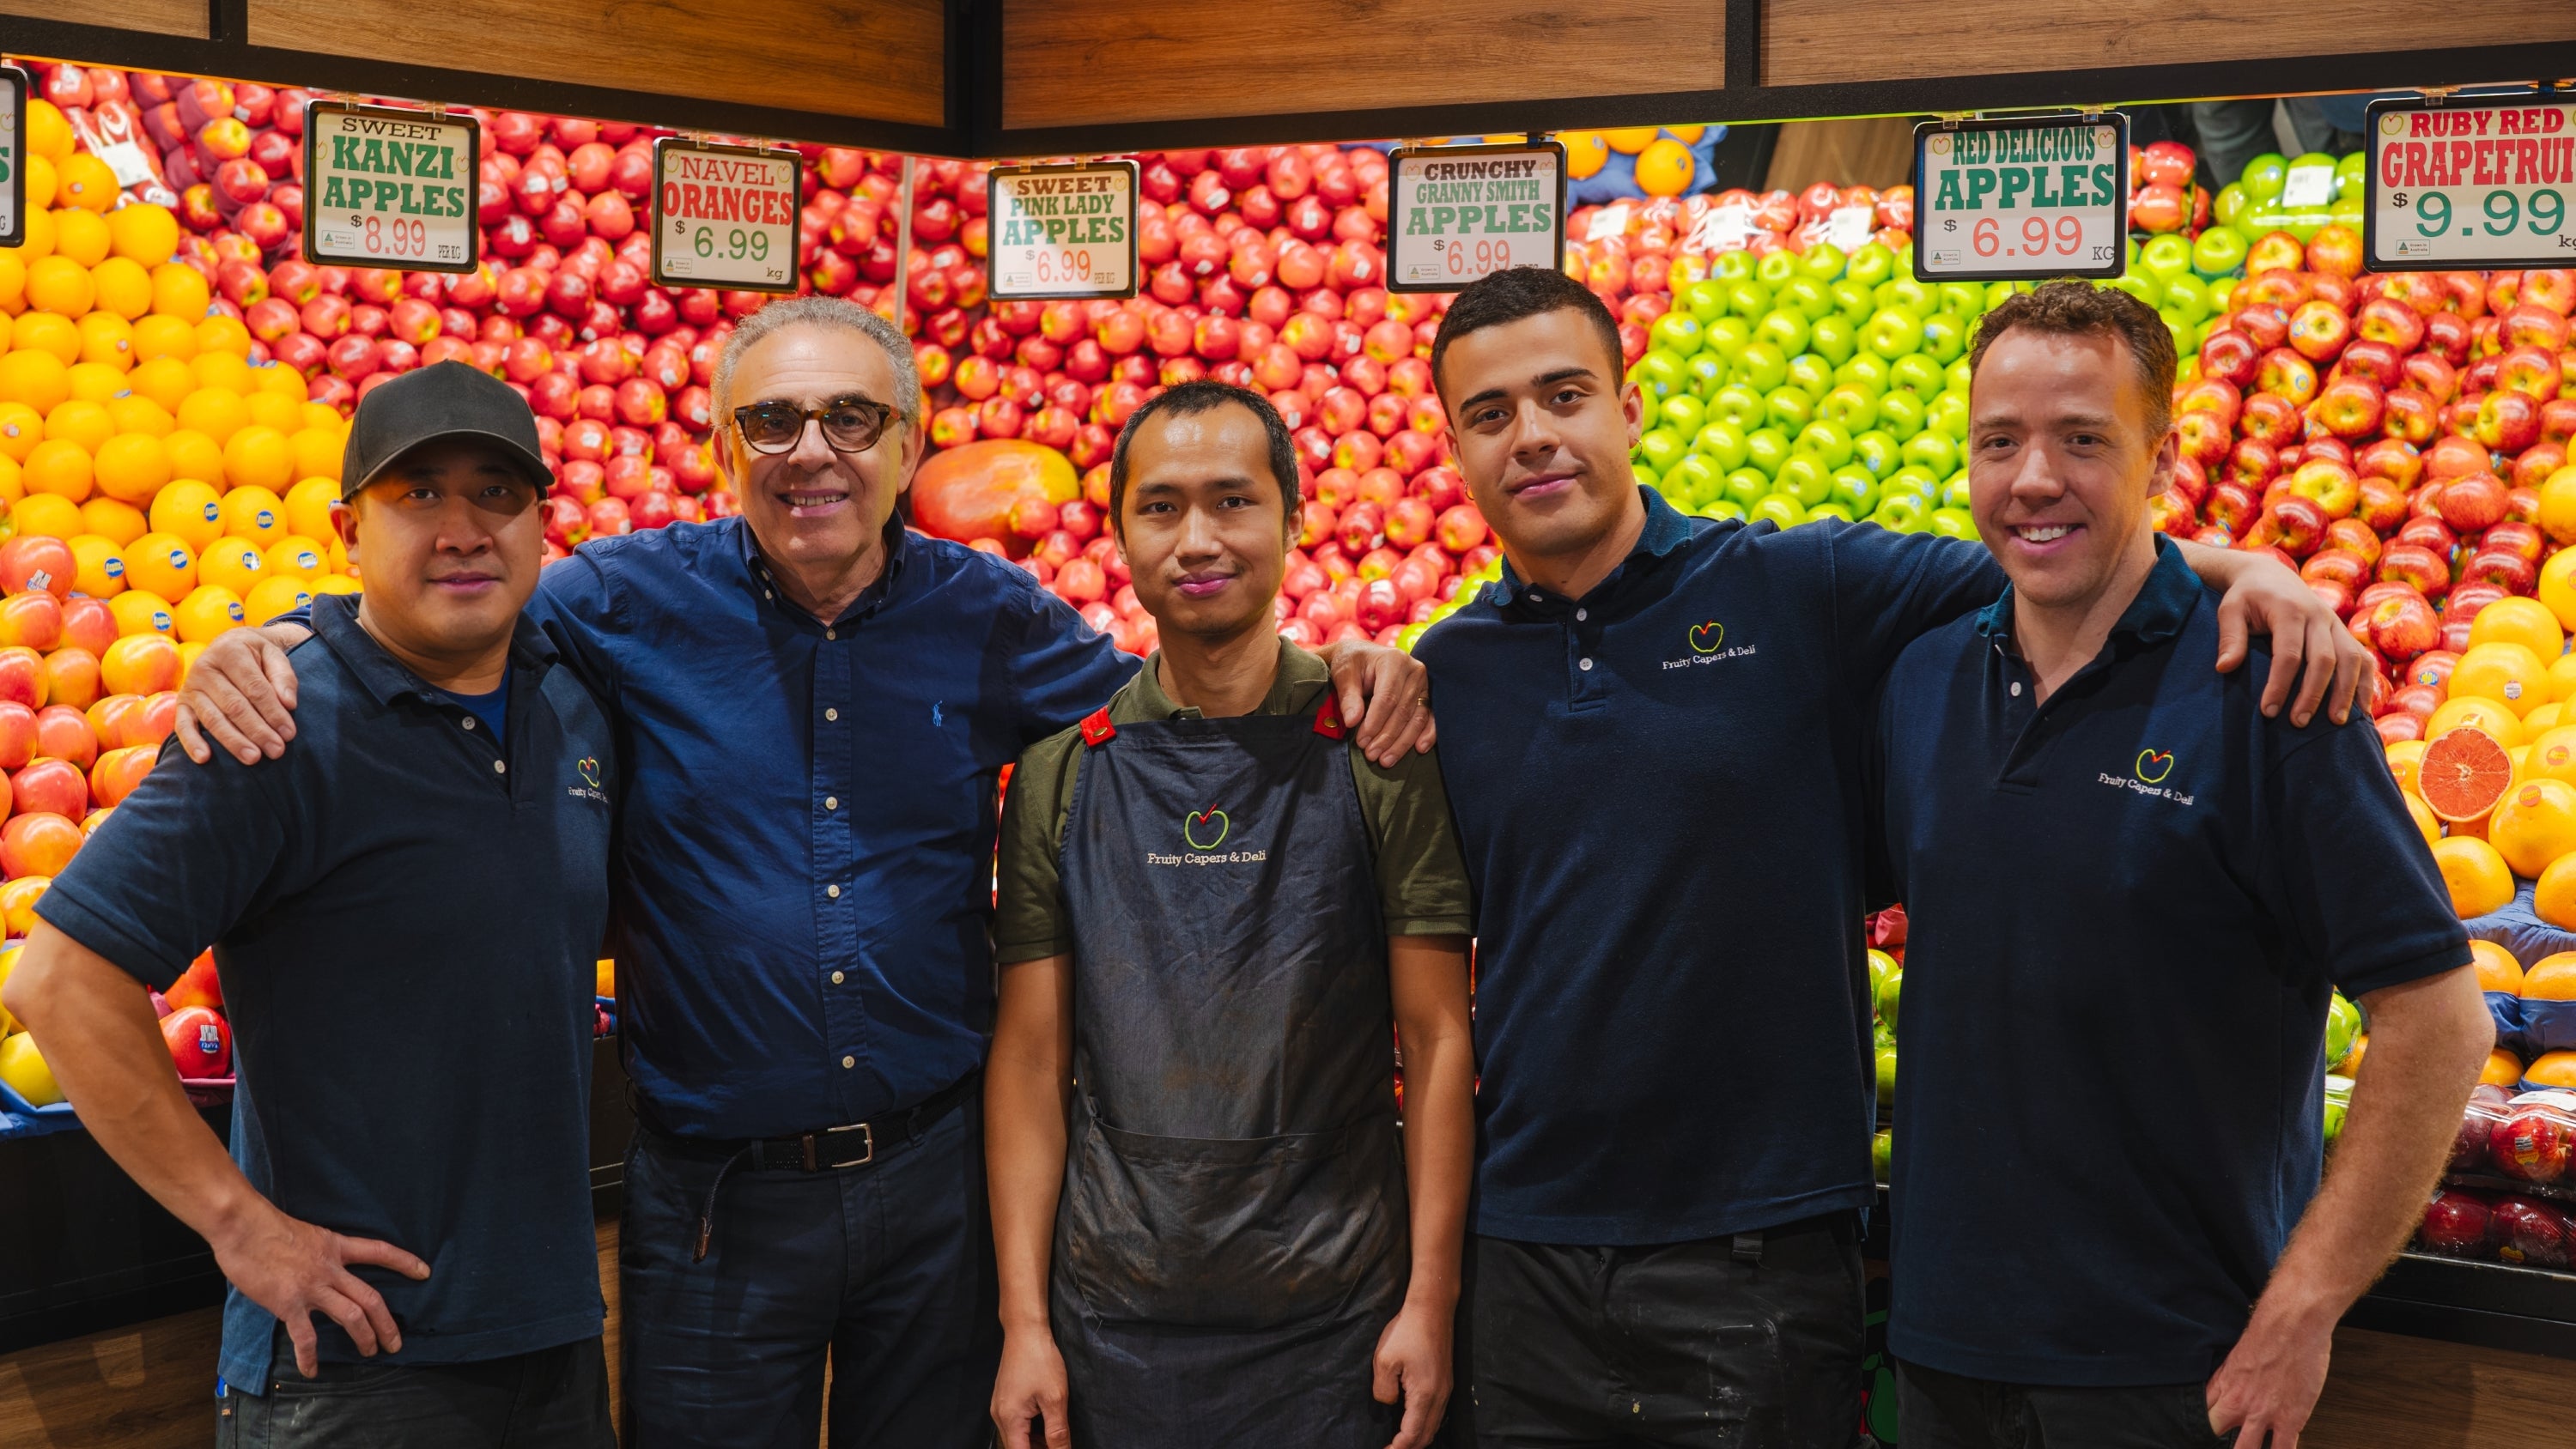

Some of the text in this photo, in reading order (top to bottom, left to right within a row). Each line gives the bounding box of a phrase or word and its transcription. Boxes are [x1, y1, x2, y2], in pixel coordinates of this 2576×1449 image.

[342, 118, 441, 141] SWEET
[2409, 108, 2565, 138] RUBY RED
[332, 135, 453, 179] KANZI
[1953, 126, 2095, 165] RED DELICIOUS
[680, 156, 775, 186] NAVEL
[1425, 160, 1536, 181] CRUNCHY
[2381, 136, 2576, 188] GRAPEFRUI
[323, 176, 465, 218] APPLES
[1017, 176, 1111, 196] SWEET
[1416, 179, 1540, 204] GRANNY SMITH
[1935, 164, 2115, 210] APPLES
[662, 181, 793, 226] ORANGES
[1010, 194, 1115, 216] PINK LADY
[1002, 216, 1125, 246] APPLES
[1406, 203, 1552, 235] APPLES
[438, 245, 451, 258] PER
[2092, 246, 2115, 260] KG
[766, 267, 783, 280] kg
[1662, 645, 1756, 670] Fruity Capers & Deli
[2098, 773, 2194, 805] Fruity Capers & Deli
[1146, 850, 1267, 867] Fruity Capers & Deli
